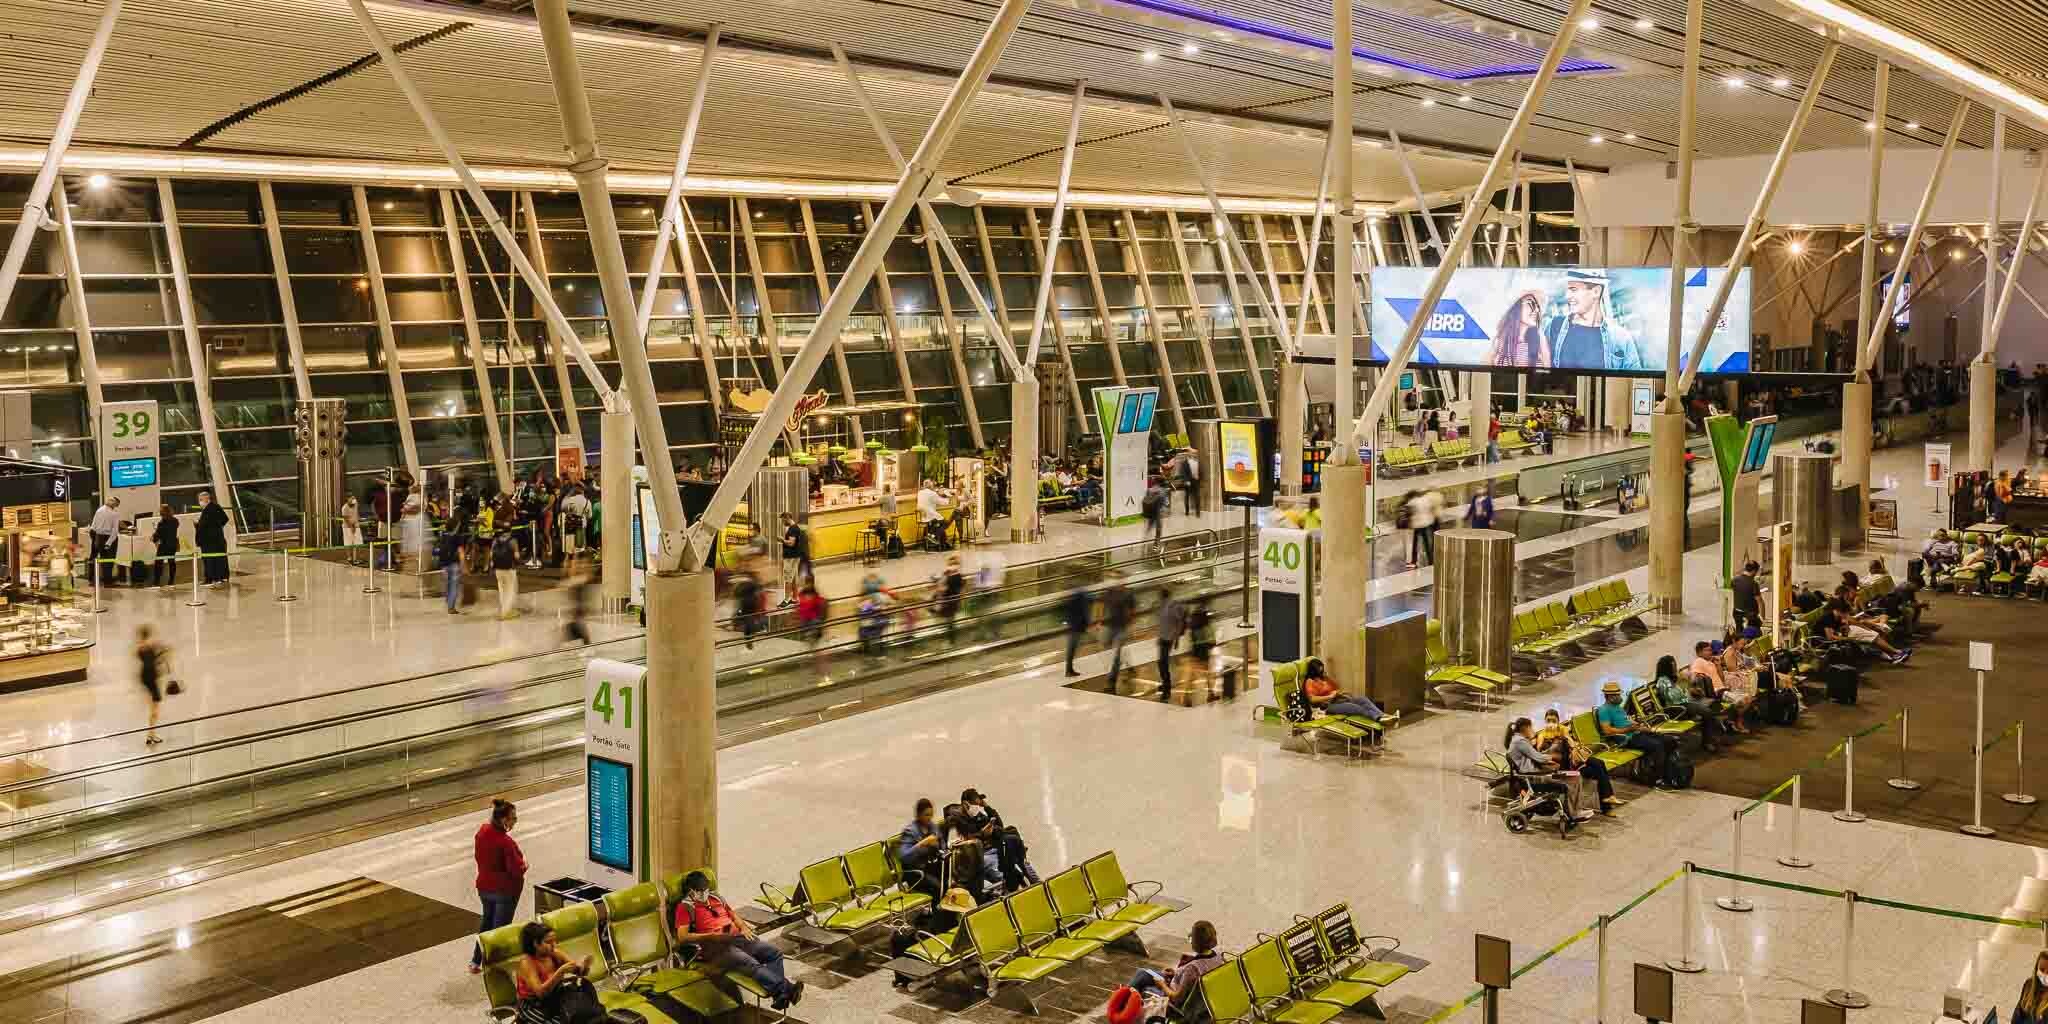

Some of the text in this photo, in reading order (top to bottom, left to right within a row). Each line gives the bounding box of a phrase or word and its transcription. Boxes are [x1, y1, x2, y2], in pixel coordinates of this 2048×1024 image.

[112, 411, 150, 438] 39
[1263, 541, 1301, 571] 40
[592, 680, 633, 729] 41
